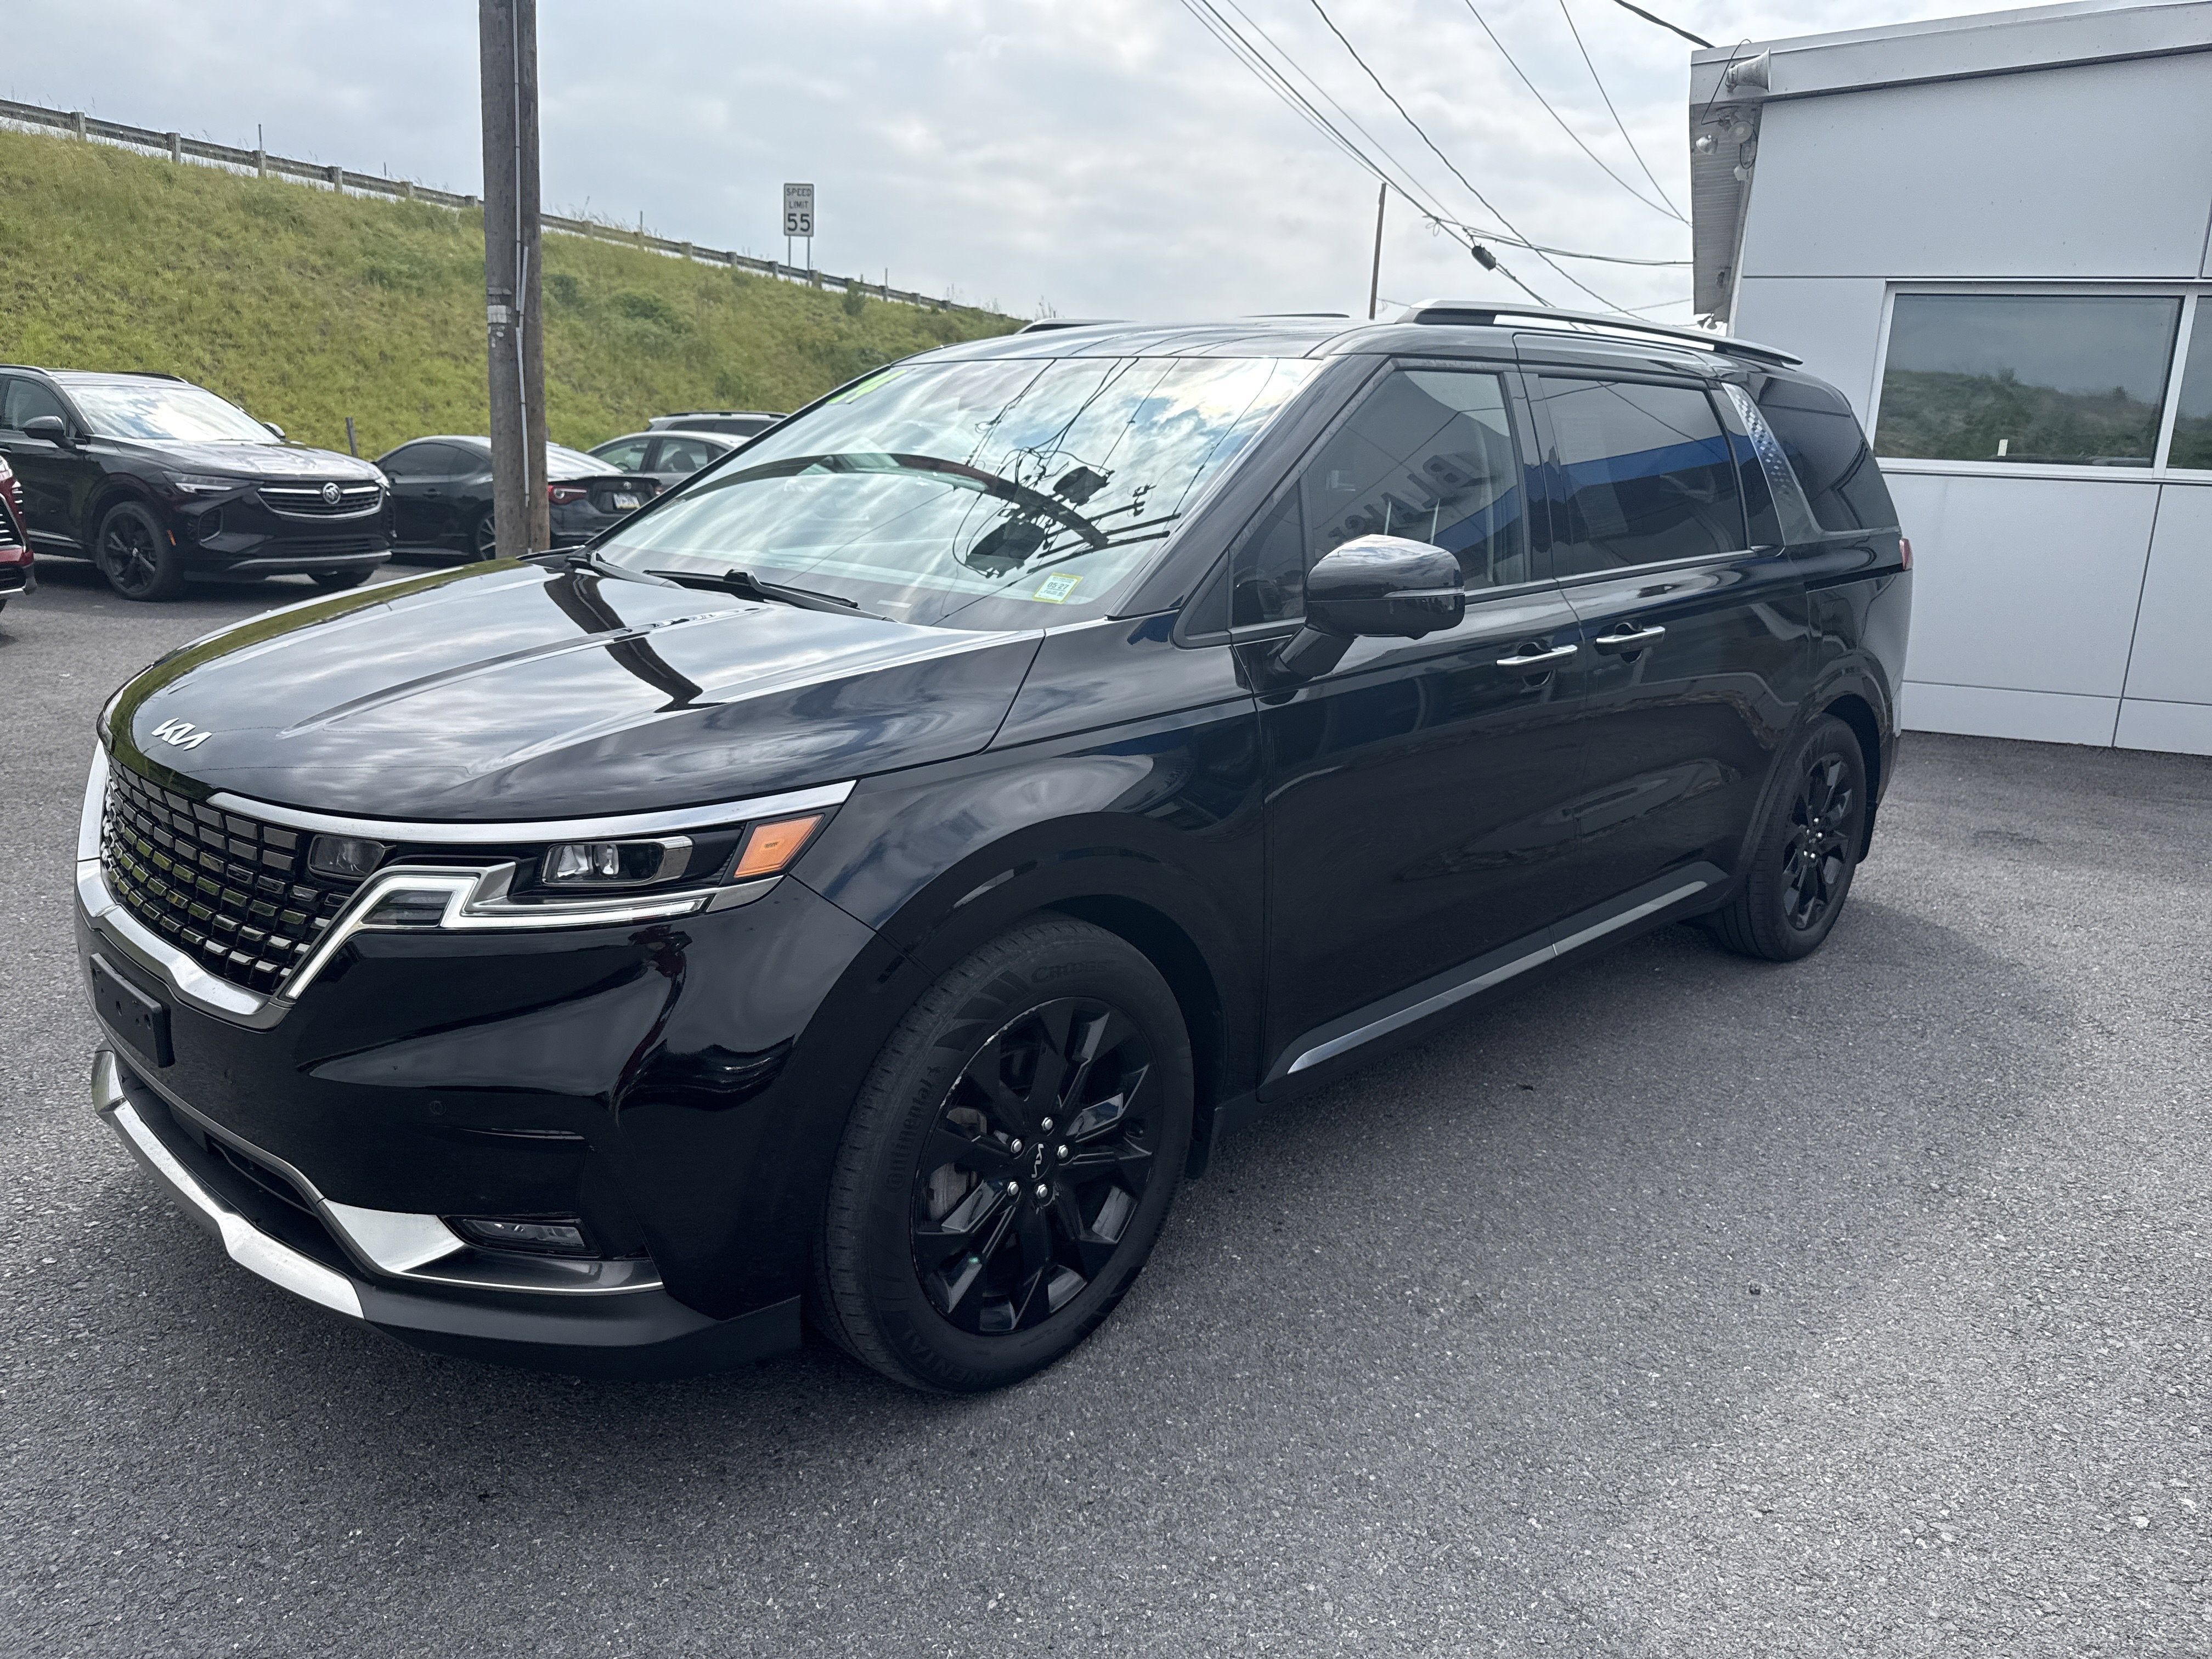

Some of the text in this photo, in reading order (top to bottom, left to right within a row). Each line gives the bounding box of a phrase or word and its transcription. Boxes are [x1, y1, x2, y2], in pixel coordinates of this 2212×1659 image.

[786, 188, 812, 196] SPEED
[787, 213, 810, 232] 55
[151, 718, 212, 751] KIA
